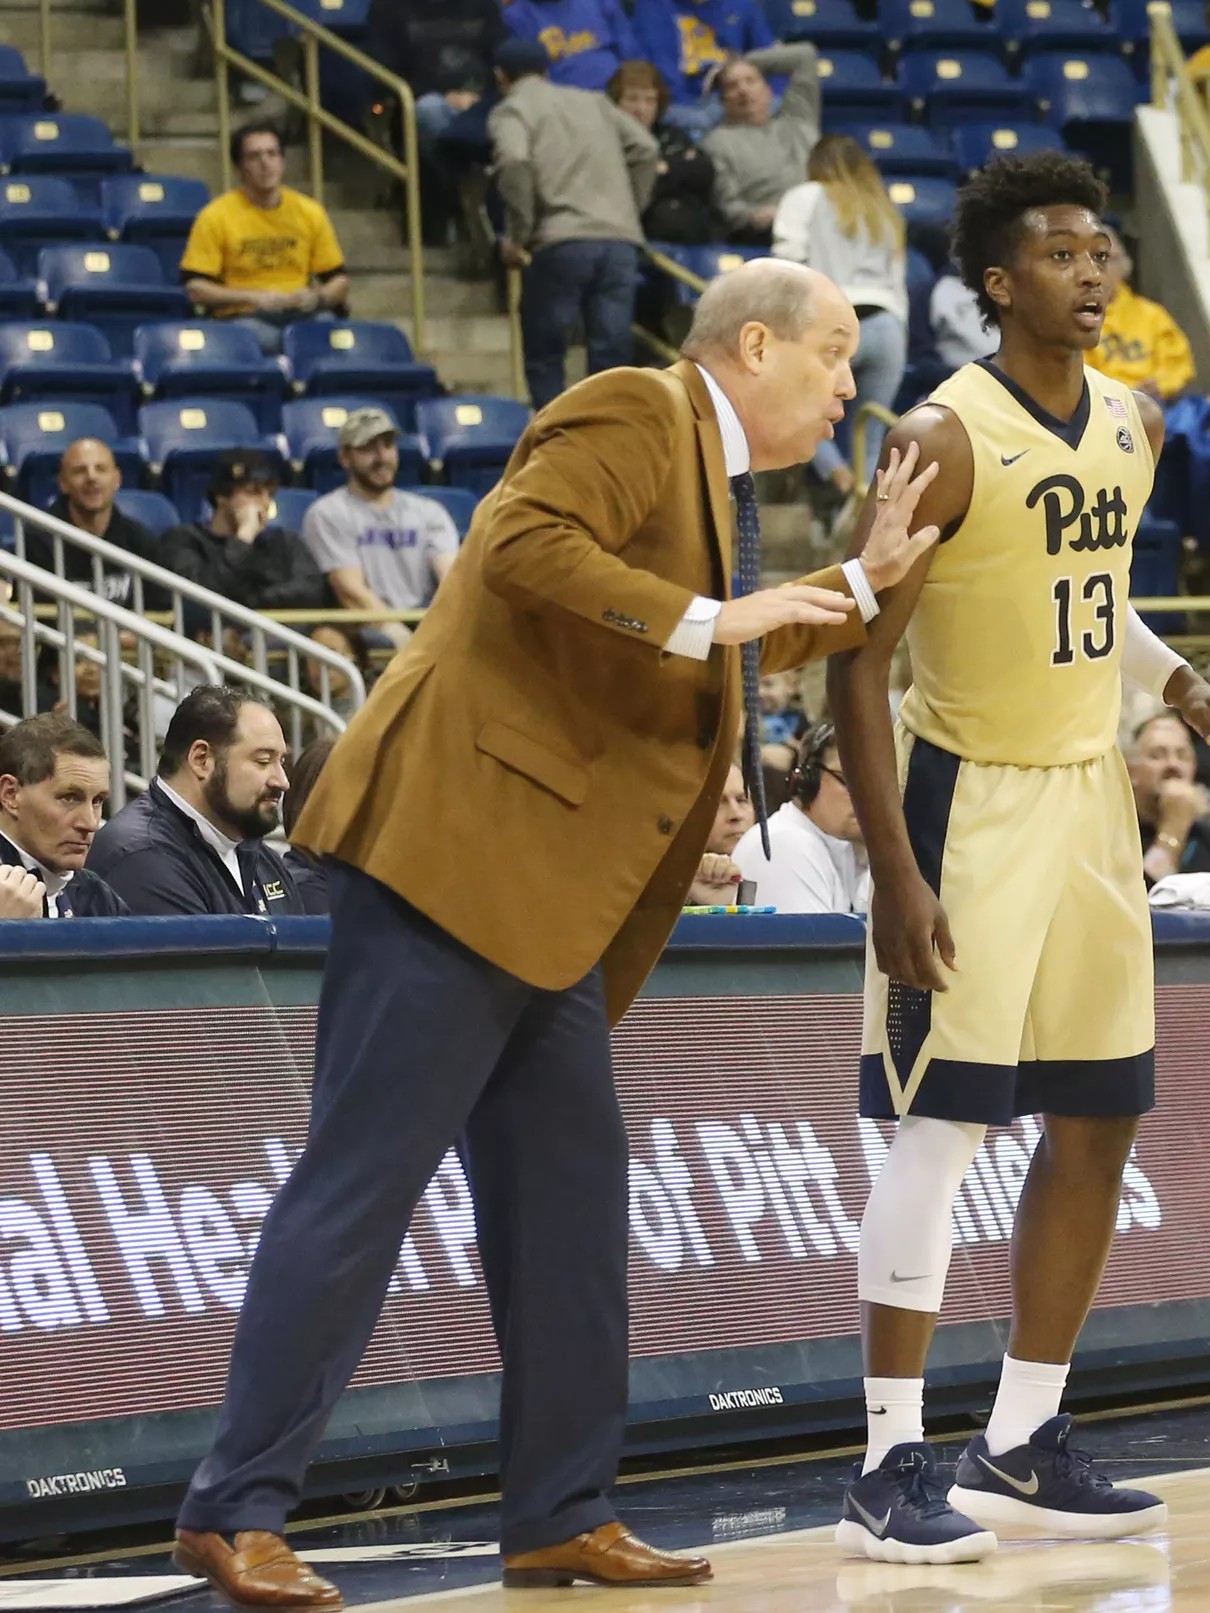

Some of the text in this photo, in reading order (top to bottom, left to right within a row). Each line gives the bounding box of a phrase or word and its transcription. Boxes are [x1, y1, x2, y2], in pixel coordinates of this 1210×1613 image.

[1026, 474, 1127, 555] Pitt
[1050, 570, 1116, 667] 13
[0, 1153, 110, 1332] al
[694, 1113, 860, 1261] Pitt
[708, 1387, 784, 1410] DAKTRONICS
[27, 1468, 127, 1498] DAKTRONICS
